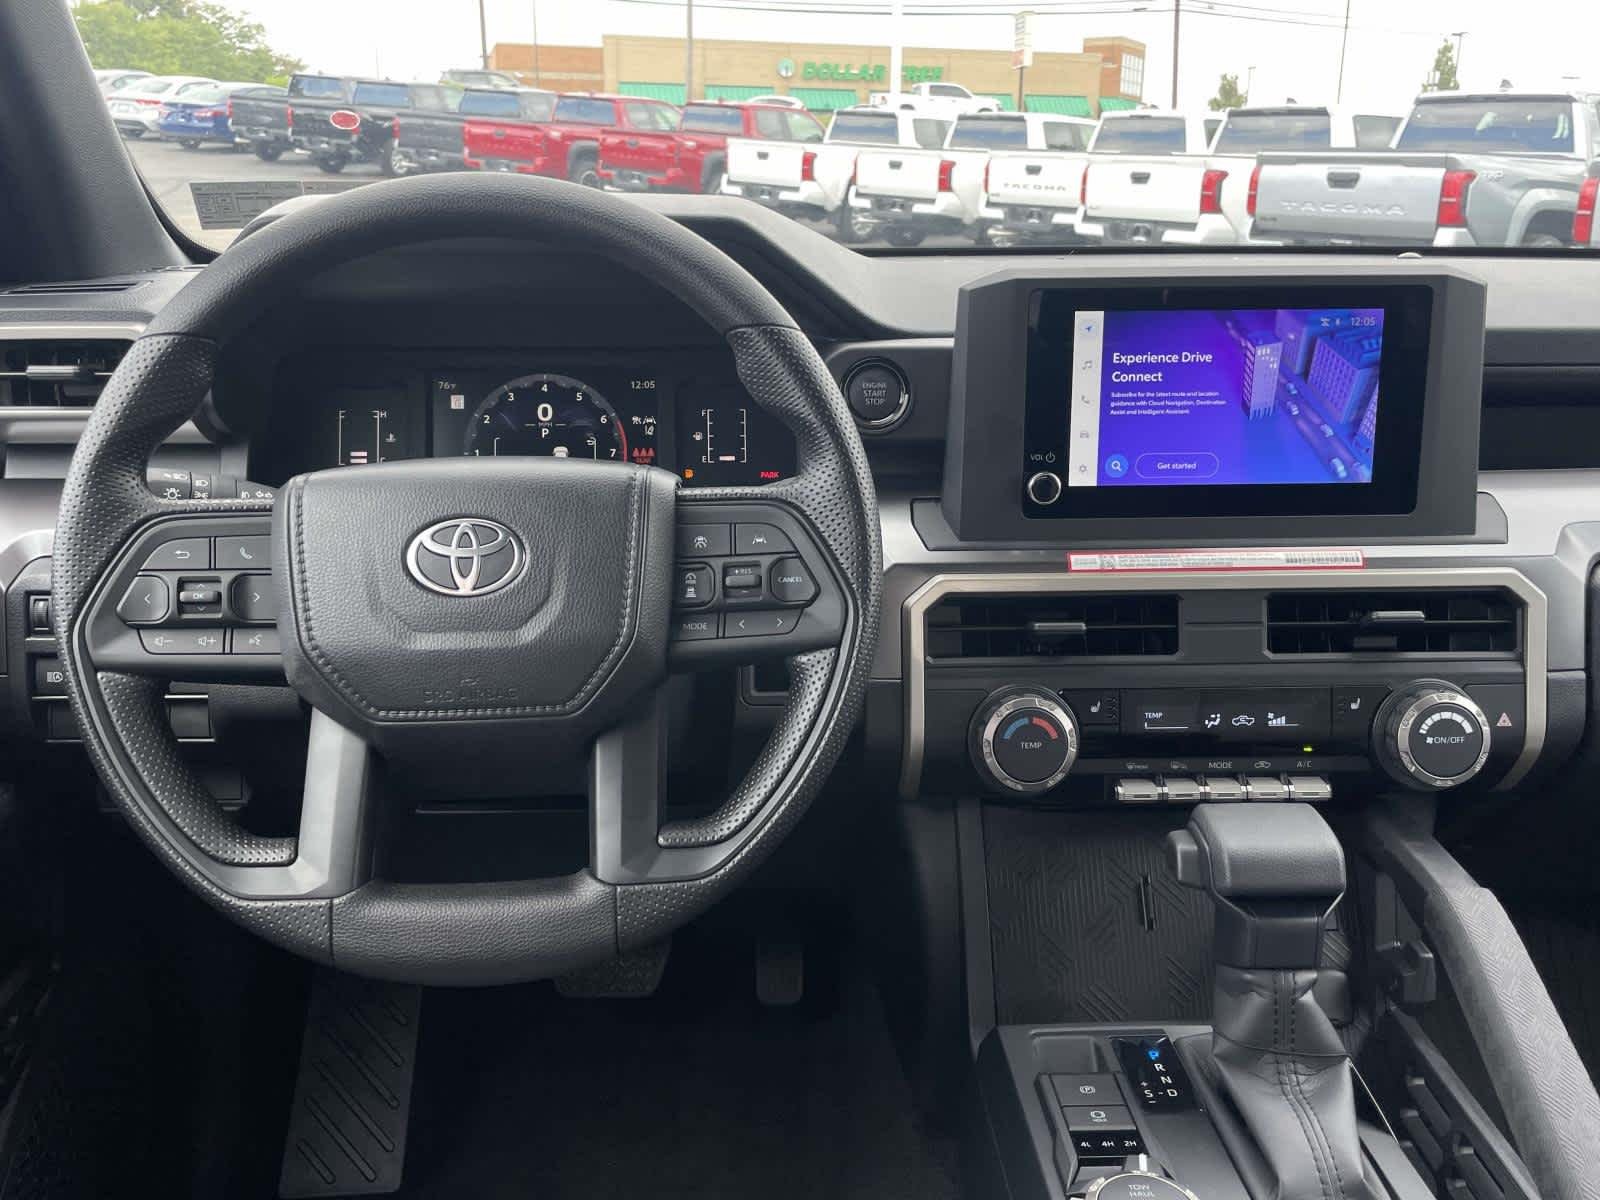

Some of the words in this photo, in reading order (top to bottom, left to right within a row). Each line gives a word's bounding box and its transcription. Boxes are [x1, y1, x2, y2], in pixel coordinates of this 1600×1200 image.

[802, 61, 887, 82] DOLLAR
[1003, 182, 1067, 192] TACOMA
[1280, 200, 1406, 217] TACOMA
[1351, 316, 1377, 327] 12:05
[1112, 351, 1179, 366] Experience
[1181, 351, 1213, 363] Drive
[1111, 371, 1163, 383] Connect
[541, 383, 549, 393] 4
[630, 380, 656, 390] 12:05
[862, 381, 887, 389] ENGINE
[507, 392, 515, 402] 3
[575, 392, 583, 402] 5
[863, 389, 887, 398] START
[865, 398, 886, 407] STOP
[483, 414, 491, 424] 2
[600, 414, 608, 424] 6
[541, 427, 550, 439] P
[609, 448, 617, 458] 7
[1157, 461, 1171, 470] Get
[1171, 461, 1197, 470] started
[760, 471, 780, 479] PARK
[777, 576, 803, 584] CANCEL
[192, 592, 205, 600] OK
[682, 622, 708, 631] MODE
[1020, 741, 1043, 750] TEMP
[1433, 736, 1465, 745] ON/OFF
[1208, 761, 1233, 769] MODE
[1296, 760, 1313, 769] A/C
[1154, 1062, 1166, 1073] R
[1160, 1075, 1173, 1085] N
[1144, 1089, 1154, 1098] S
[1167, 1088, 1178, 1098] D
[1081, 1140, 1092, 1148] 4L
[1101, 1140, 1115, 1148] 4H
[1123, 1139, 1137, 1147] 2H
